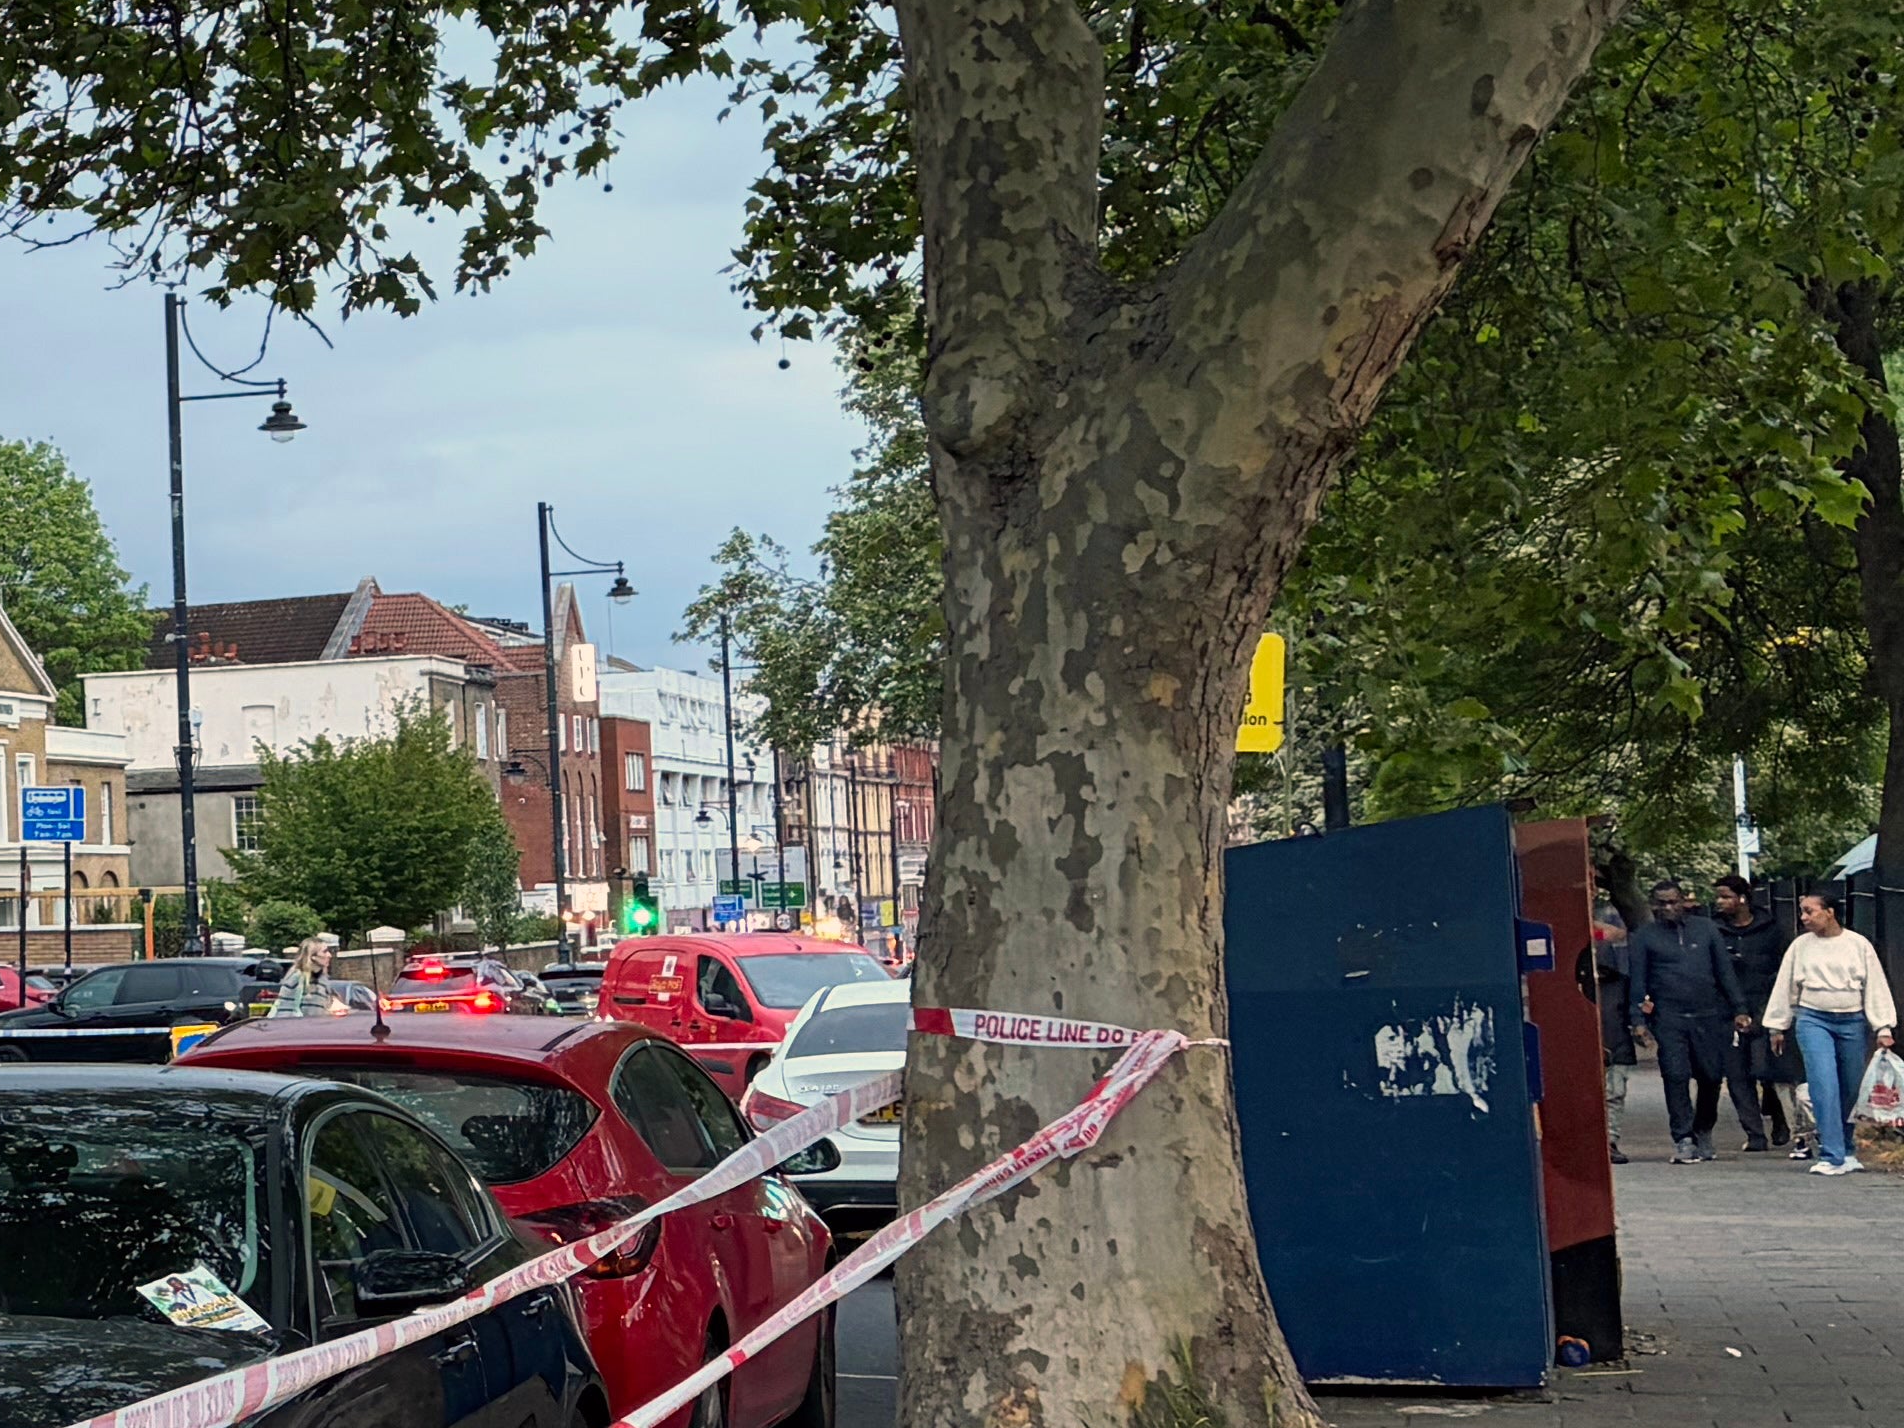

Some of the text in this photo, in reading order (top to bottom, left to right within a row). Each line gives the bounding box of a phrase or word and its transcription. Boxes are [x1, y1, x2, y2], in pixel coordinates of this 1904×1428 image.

[1244, 713, 1267, 725] ion
[974, 1014, 1041, 1042] POLICE
[1047, 1021, 1091, 1043] LINE
[1097, 1028, 1124, 1044] DO
